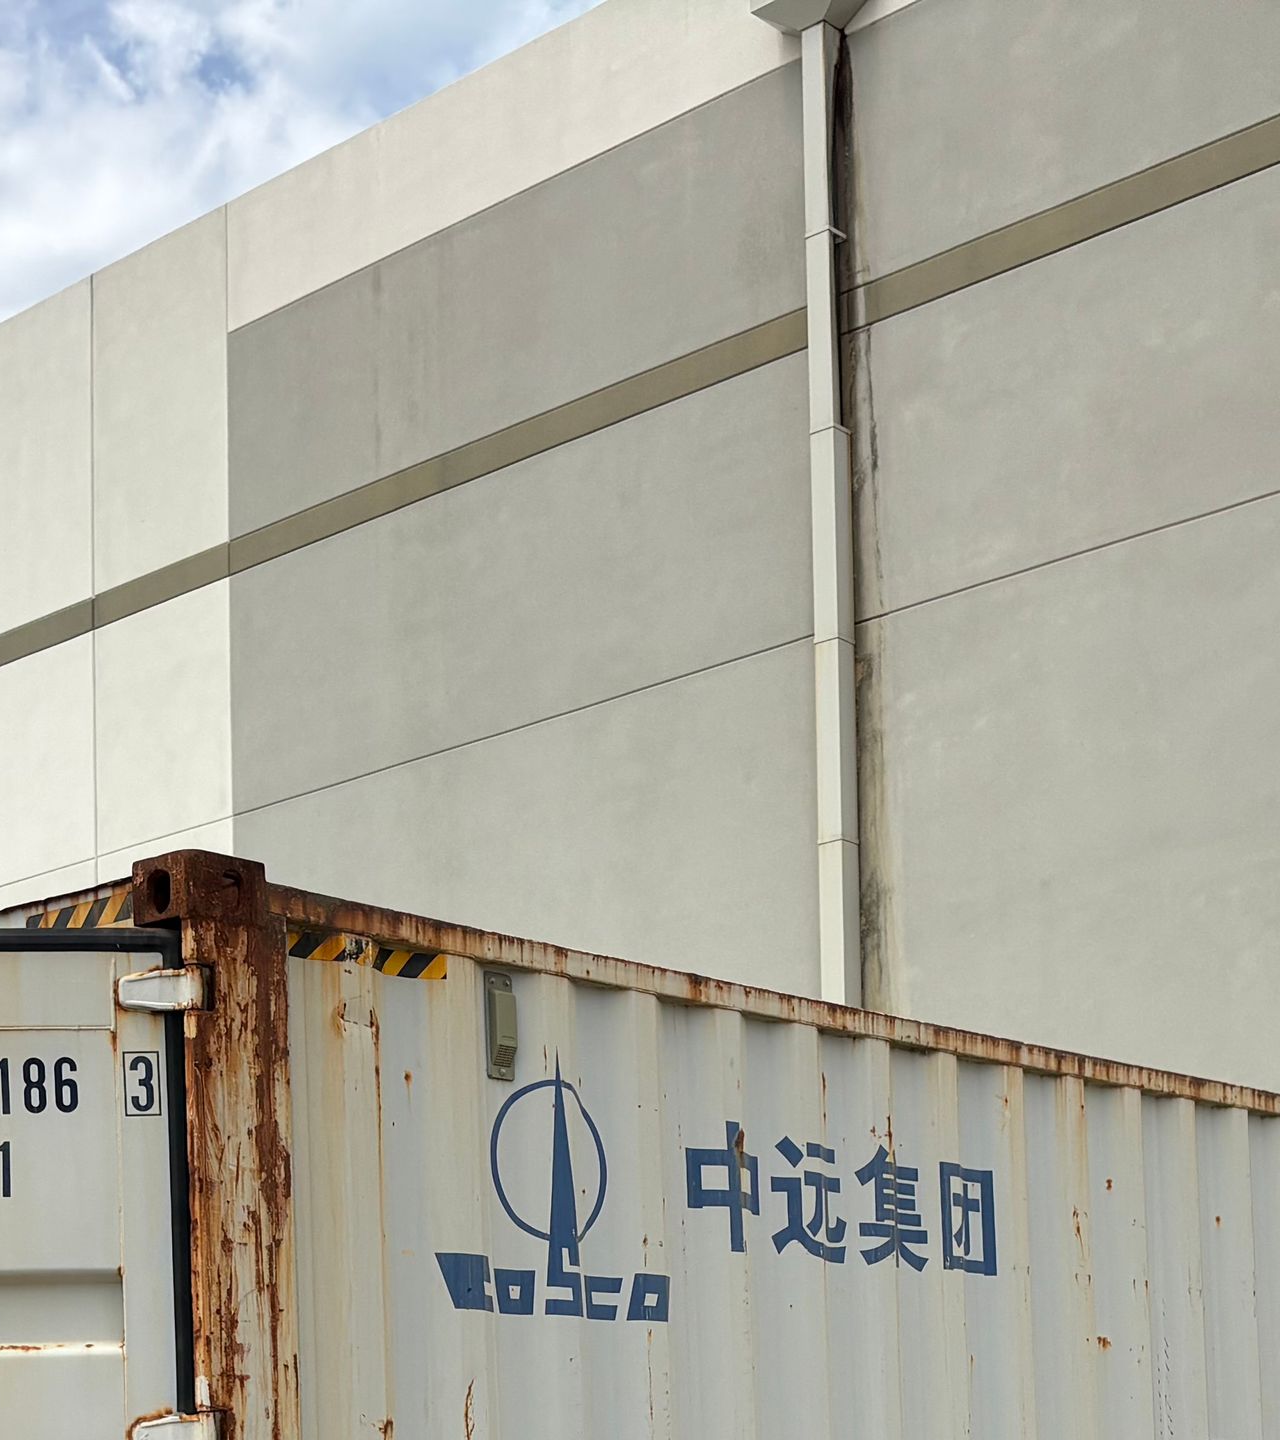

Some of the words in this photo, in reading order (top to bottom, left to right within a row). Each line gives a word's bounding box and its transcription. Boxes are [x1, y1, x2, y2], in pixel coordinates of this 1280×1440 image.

[129, 1055, 156, 1113] 3
[684, 1120, 999, 1278] 中远集团
